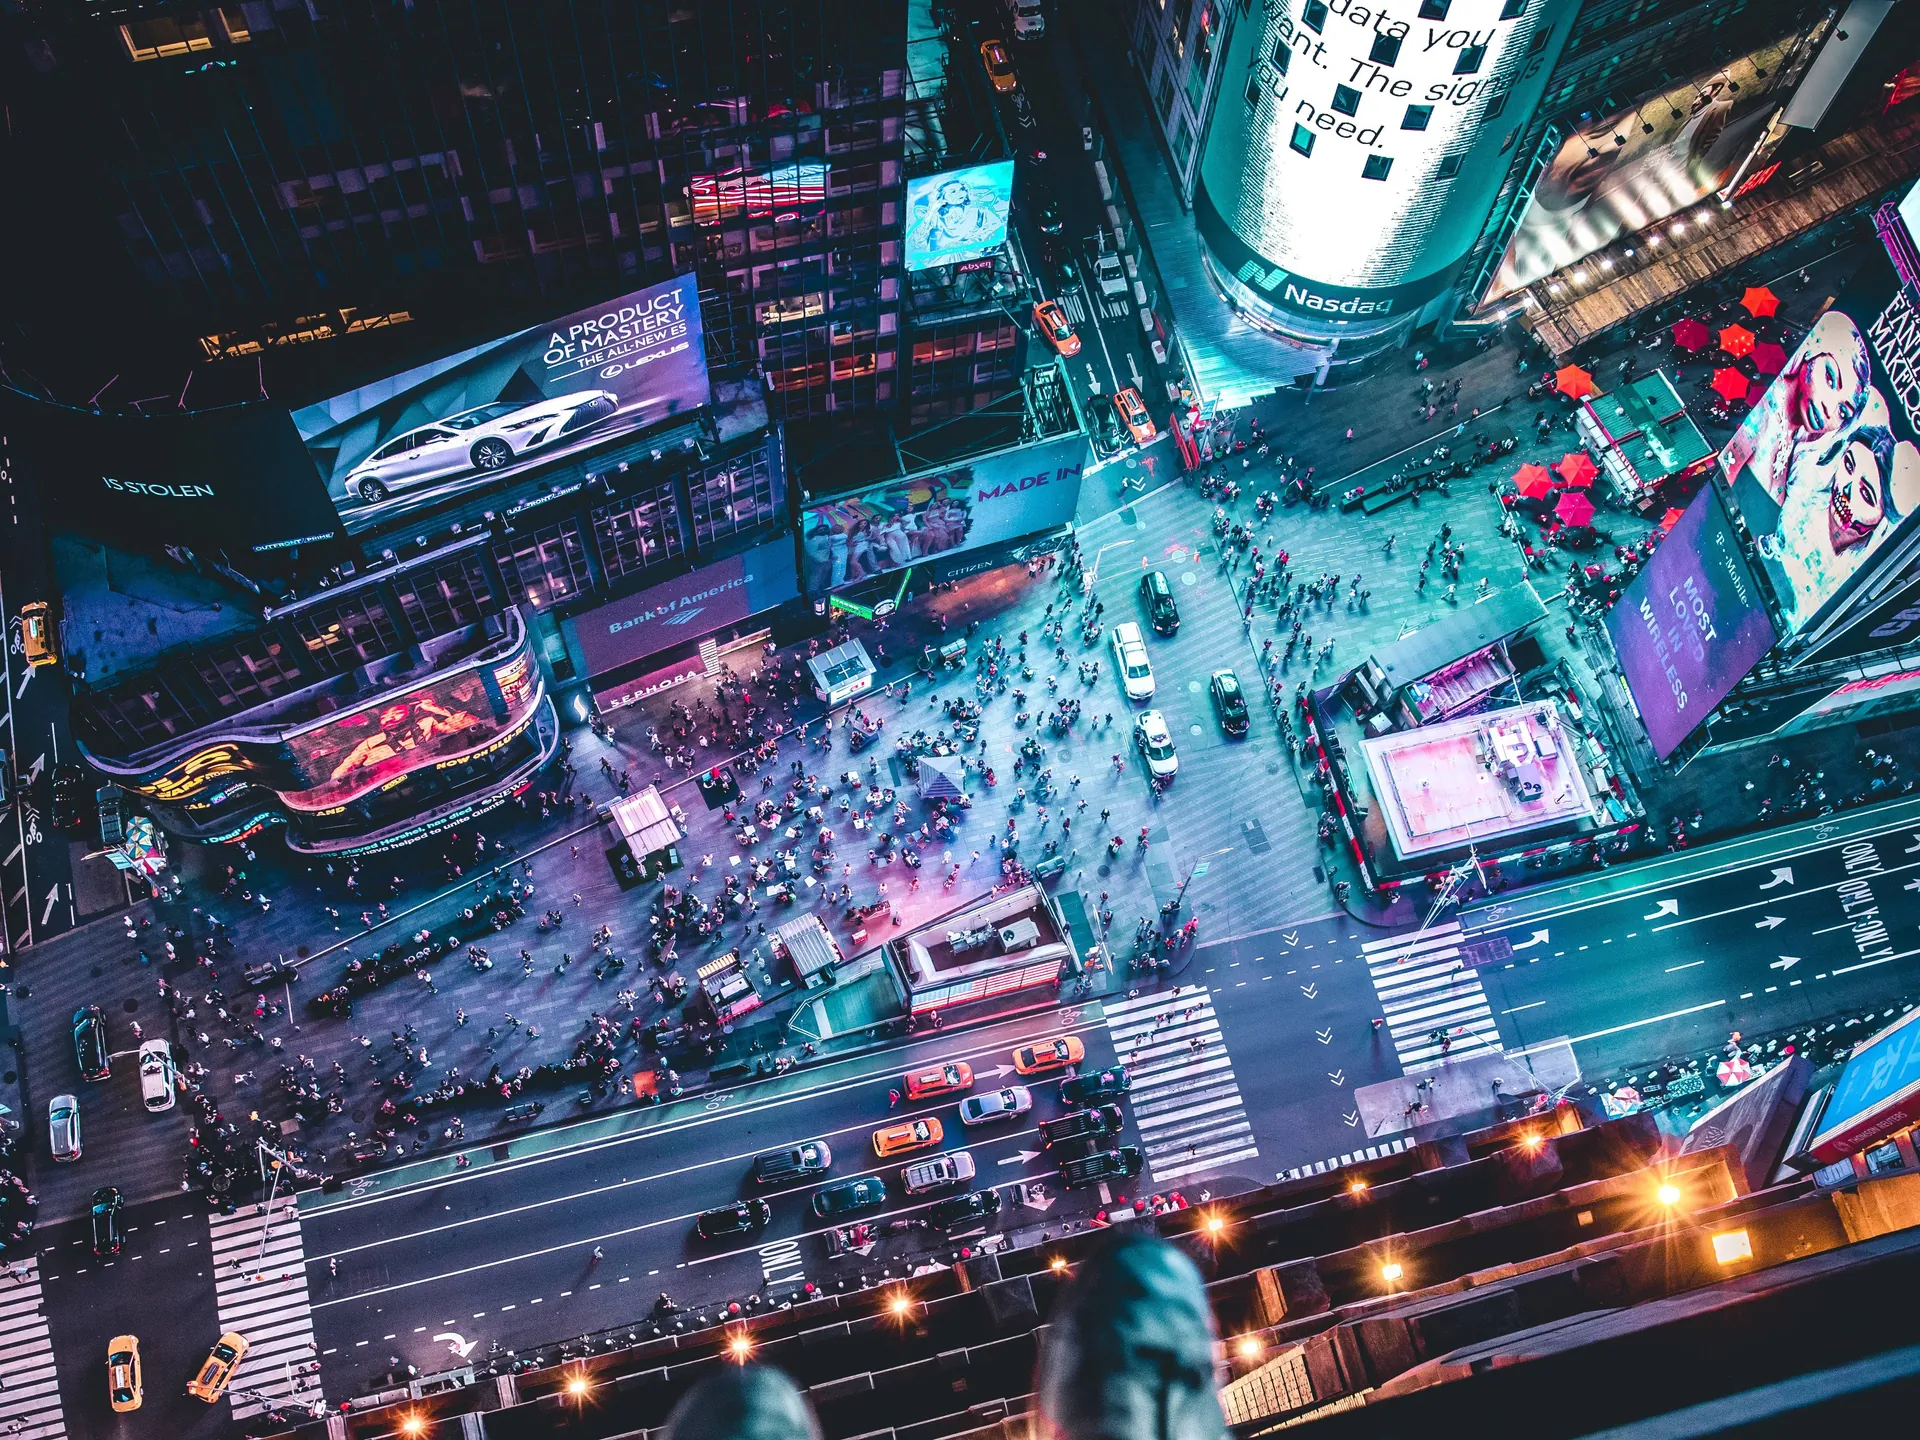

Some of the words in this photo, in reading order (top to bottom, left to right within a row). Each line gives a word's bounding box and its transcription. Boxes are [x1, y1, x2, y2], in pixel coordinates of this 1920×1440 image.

[1423, 28, 1496, 52] you
[1350, 57, 1413, 97] The
[1295, 99, 1385, 148] need.
[549, 332, 566, 348] A
[569, 288, 683, 341] PRODUCT
[1283, 283, 1394, 315] Nasdaq
[543, 343, 576, 365] OF
[581, 304, 684, 353] MASTERY
[577, 352, 605, 368] THE
[607, 328, 667, 359] ALL-NEW
[671, 323, 688, 336] ES
[624, 341, 690, 370] LEXUS
[102, 476, 124, 491] IS
[124, 481, 215, 497] STOLEN
[978, 471, 1051, 502] MADE
[1056, 463, 1081, 480] IN
[947, 560, 993, 578] CITIZEN
[609, 610, 656, 634] Bank
[658, 600, 677, 615] of
[679, 573, 754, 608] America
[1683, 576, 1717, 642] MOST
[1668, 625, 1684, 653] IN
[1669, 586, 1705, 663] LOVED
[610, 670, 697, 708] SEPHORA
[436, 754, 471, 770] NOW
[472, 749, 488, 760] ON
[492, 777, 529, 802] NEWS
[449, 806, 472, 820] died
[390, 832, 429, 850] helped
[431, 829, 442, 837] to
[1841, 842, 1884, 875] ONLY
[1836, 880, 1880, 919] ONLY
[1851, 920, 1894, 960] ONLY
[1876, 1111, 1908, 1131] REUTERS
[758, 1241, 806, 1286] ONLY
